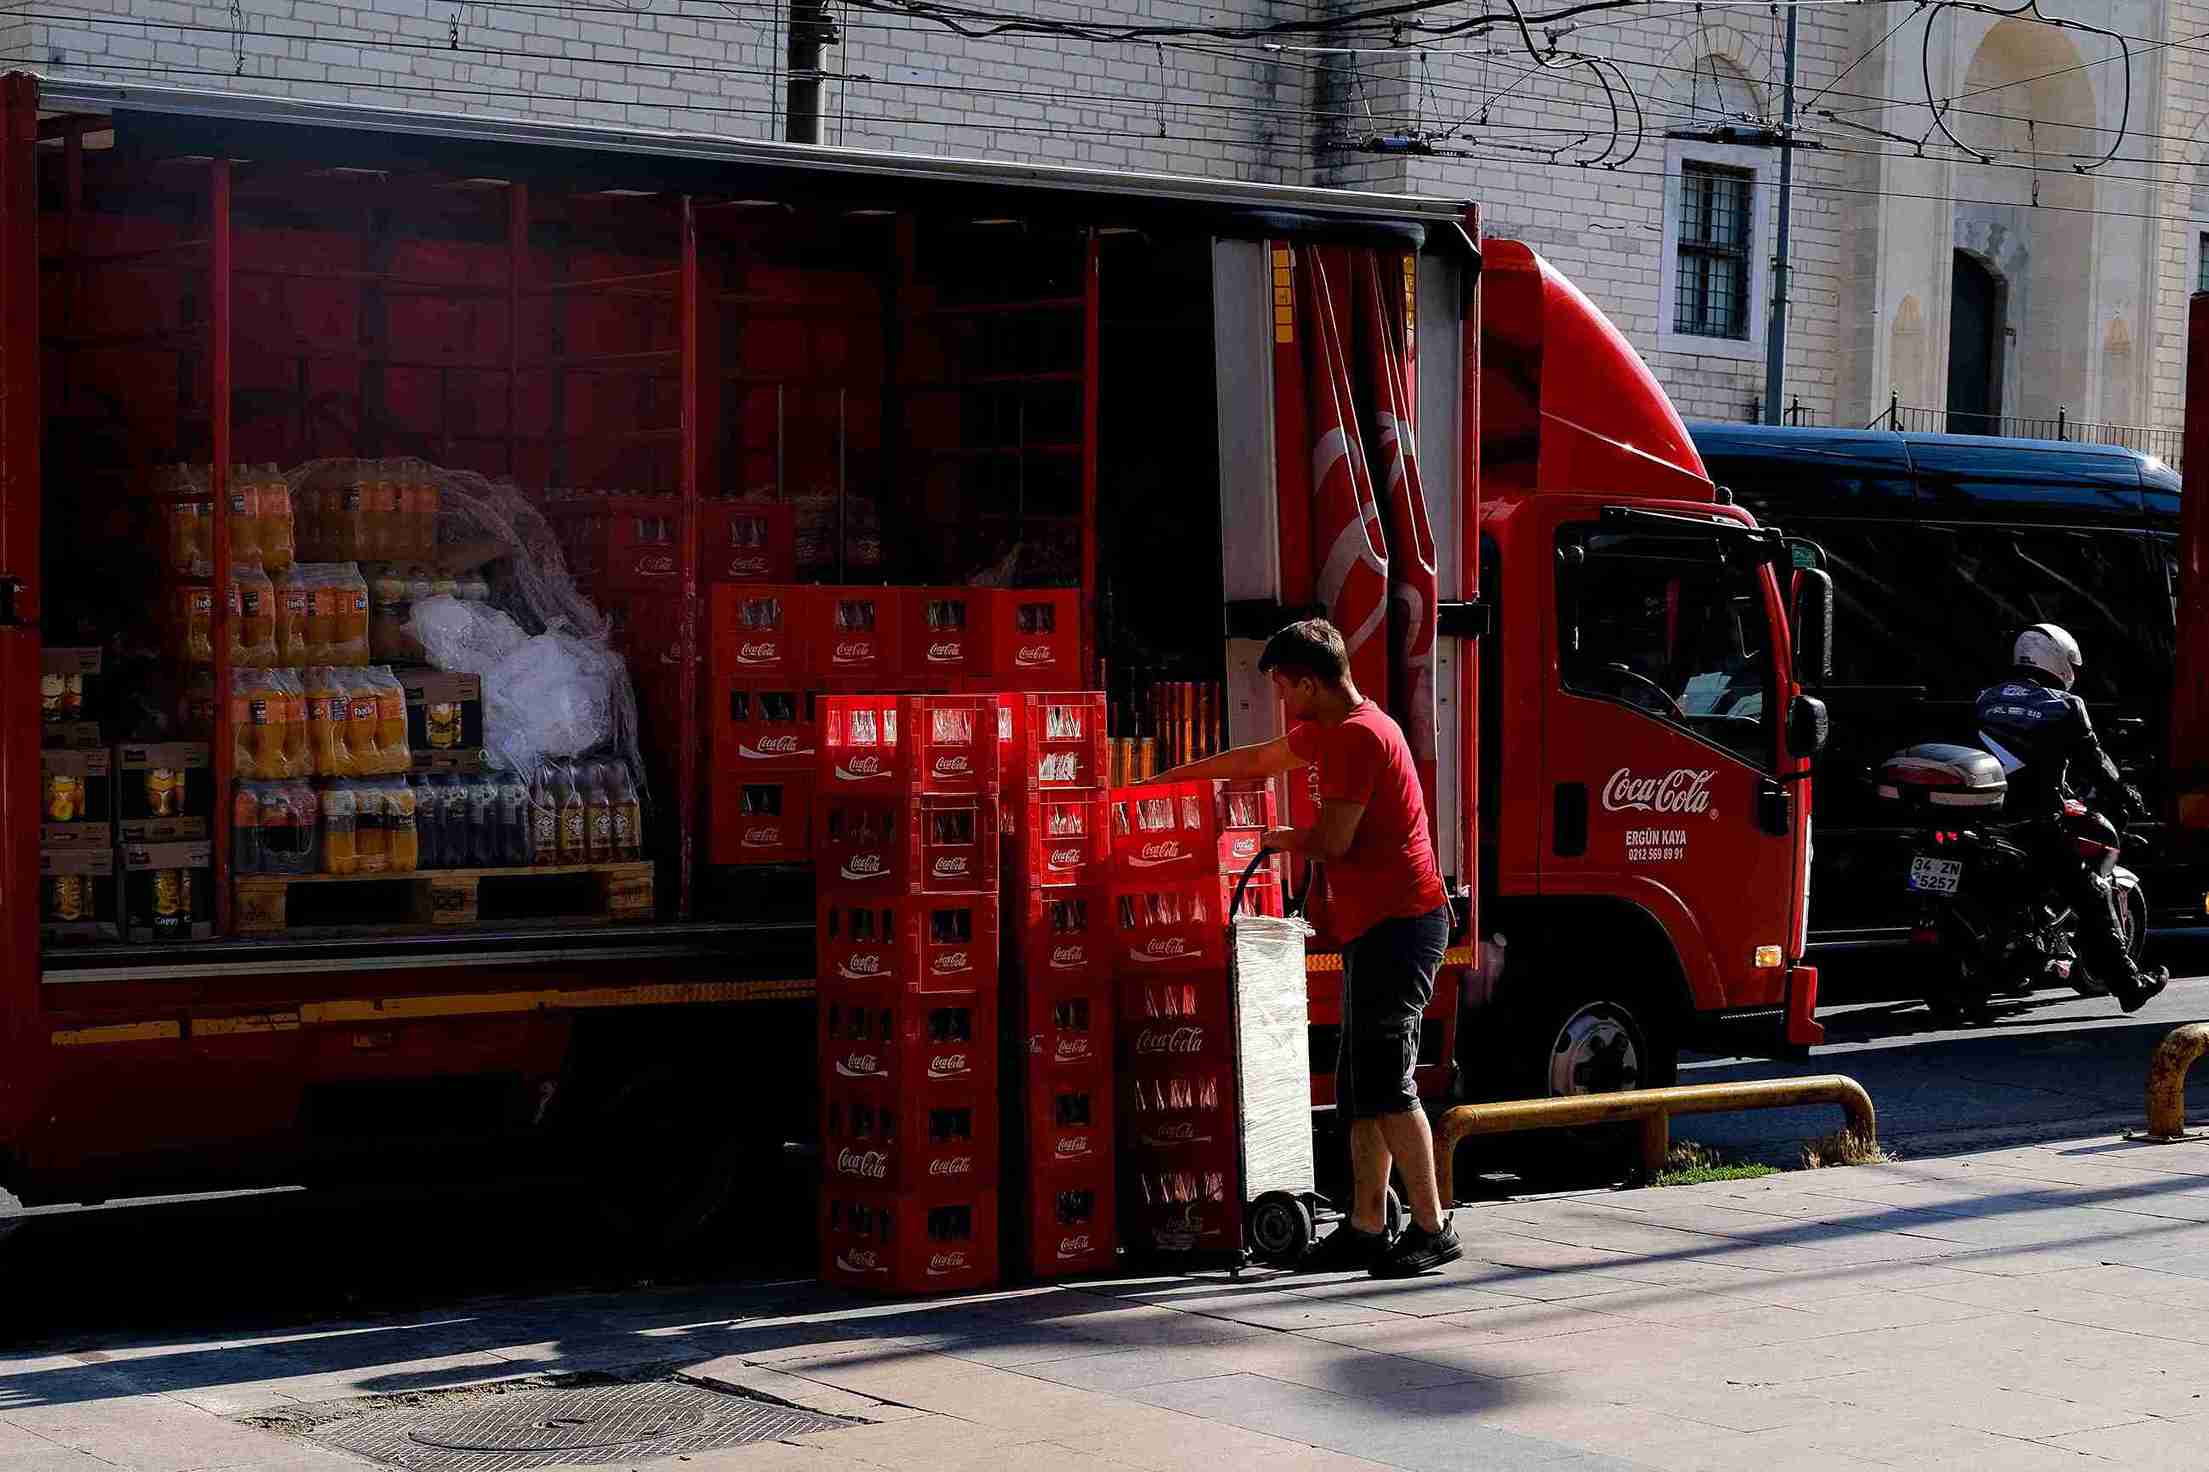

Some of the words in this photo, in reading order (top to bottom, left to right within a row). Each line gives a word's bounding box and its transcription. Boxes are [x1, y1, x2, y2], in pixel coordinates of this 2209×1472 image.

[1602, 768, 1717, 812] Coca-Cola
[1625, 828, 1660, 845] ERGÜN
[1662, 830, 1687, 844] KAYA
[1628, 848, 1647, 861] 0212
[1914, 859, 1931, 870] 34
[1940, 862, 1960, 875] ZN
[1920, 875, 1956, 889] 5257
